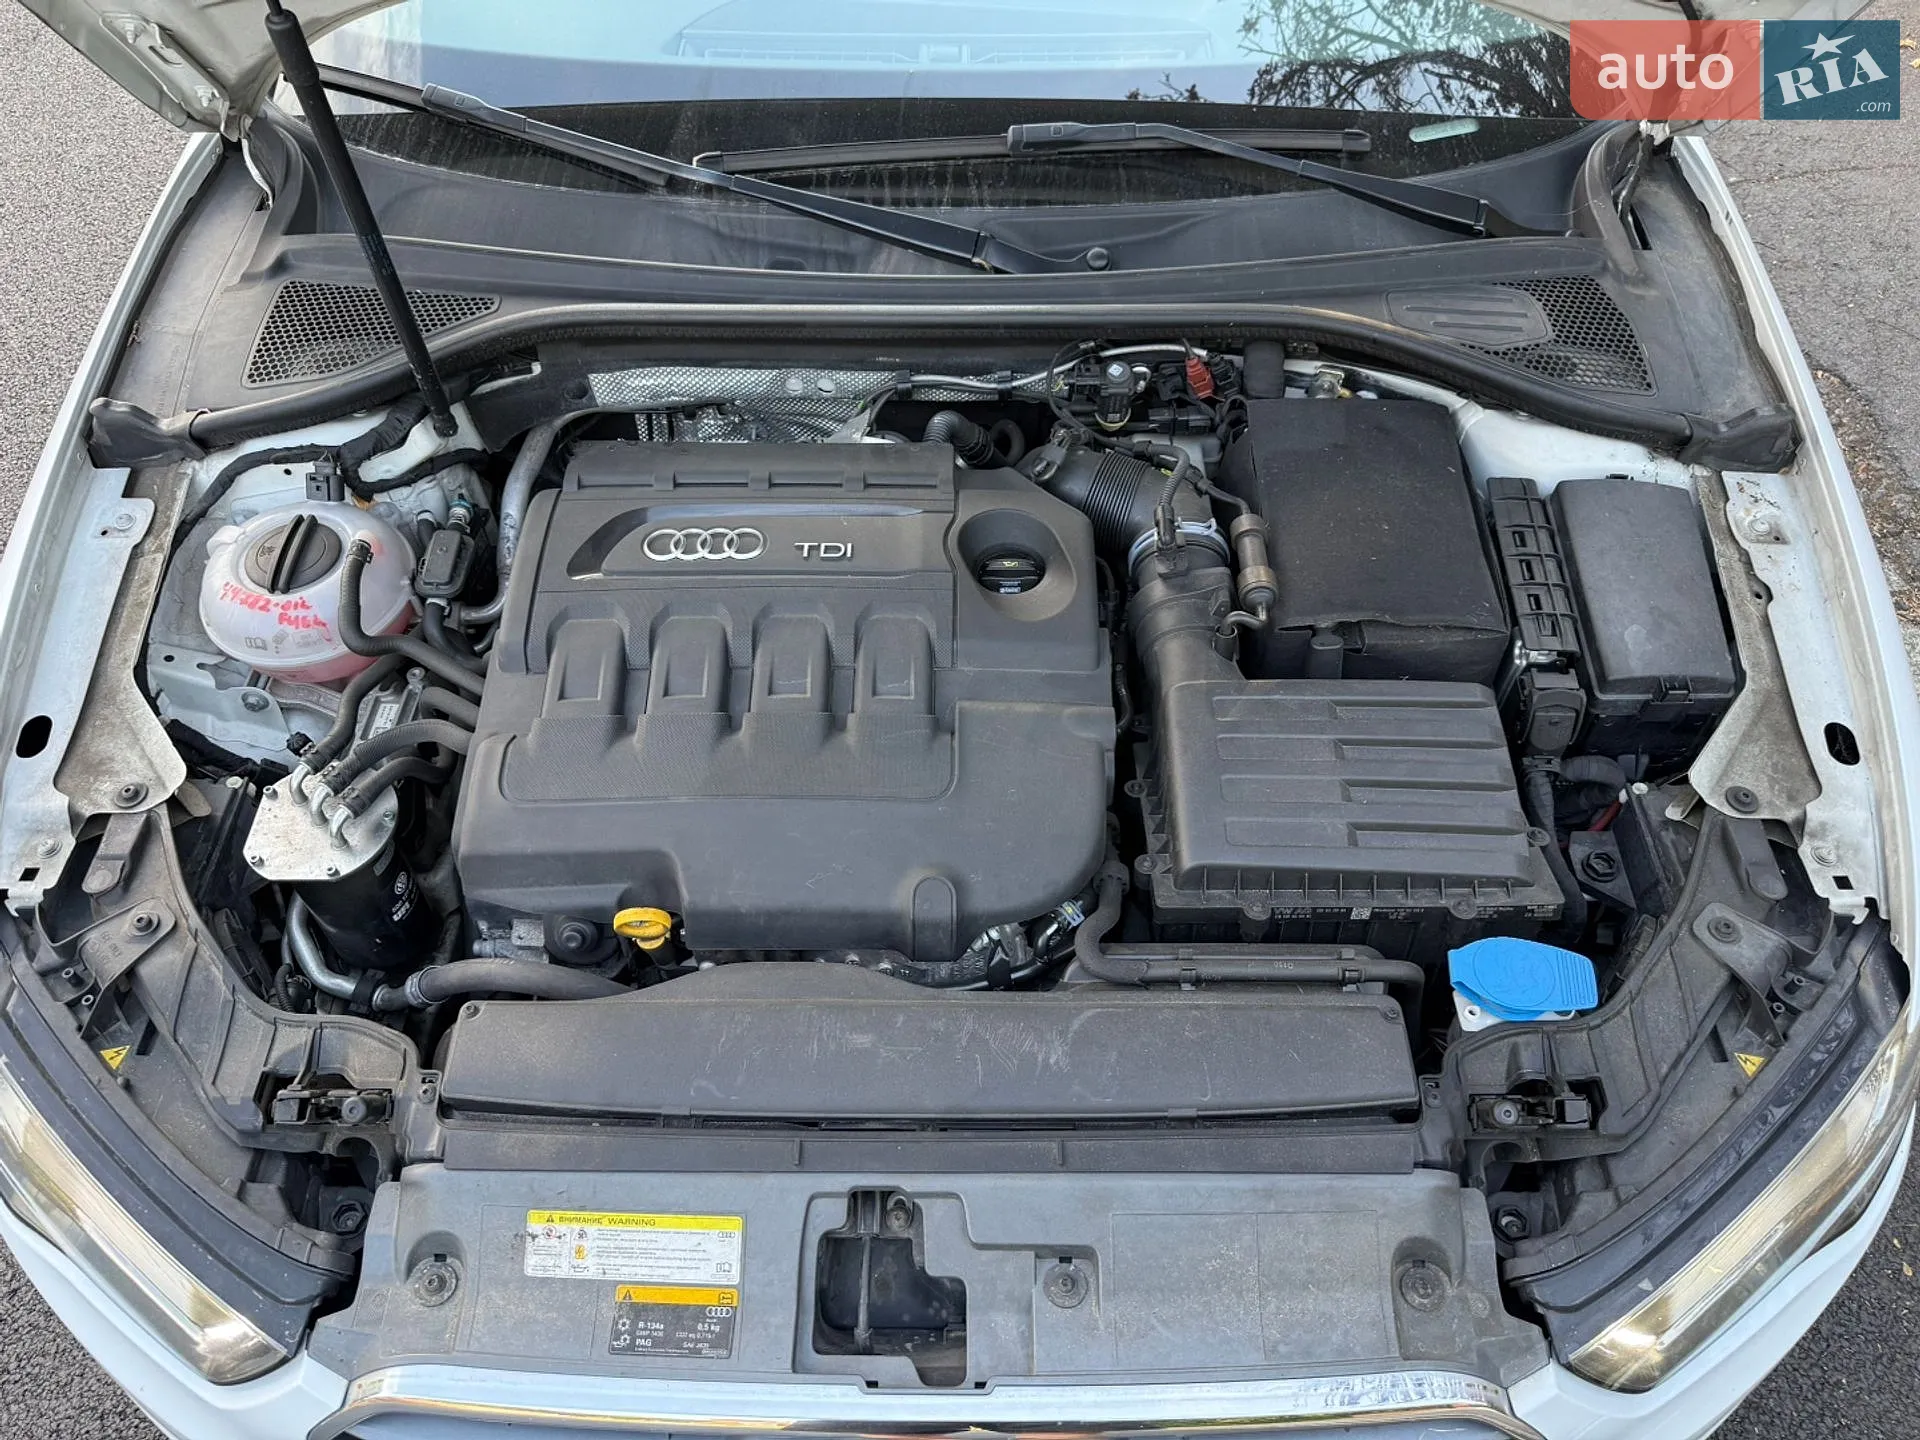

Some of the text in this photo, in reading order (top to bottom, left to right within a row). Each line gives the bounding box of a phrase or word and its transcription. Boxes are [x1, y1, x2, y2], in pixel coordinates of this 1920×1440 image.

[794, 542, 853, 558] TDI
[608, 1216, 656, 1227] WARNING
[638, 1321, 664, 1330] R-134a
[635, 1338, 652, 1346] PAG
